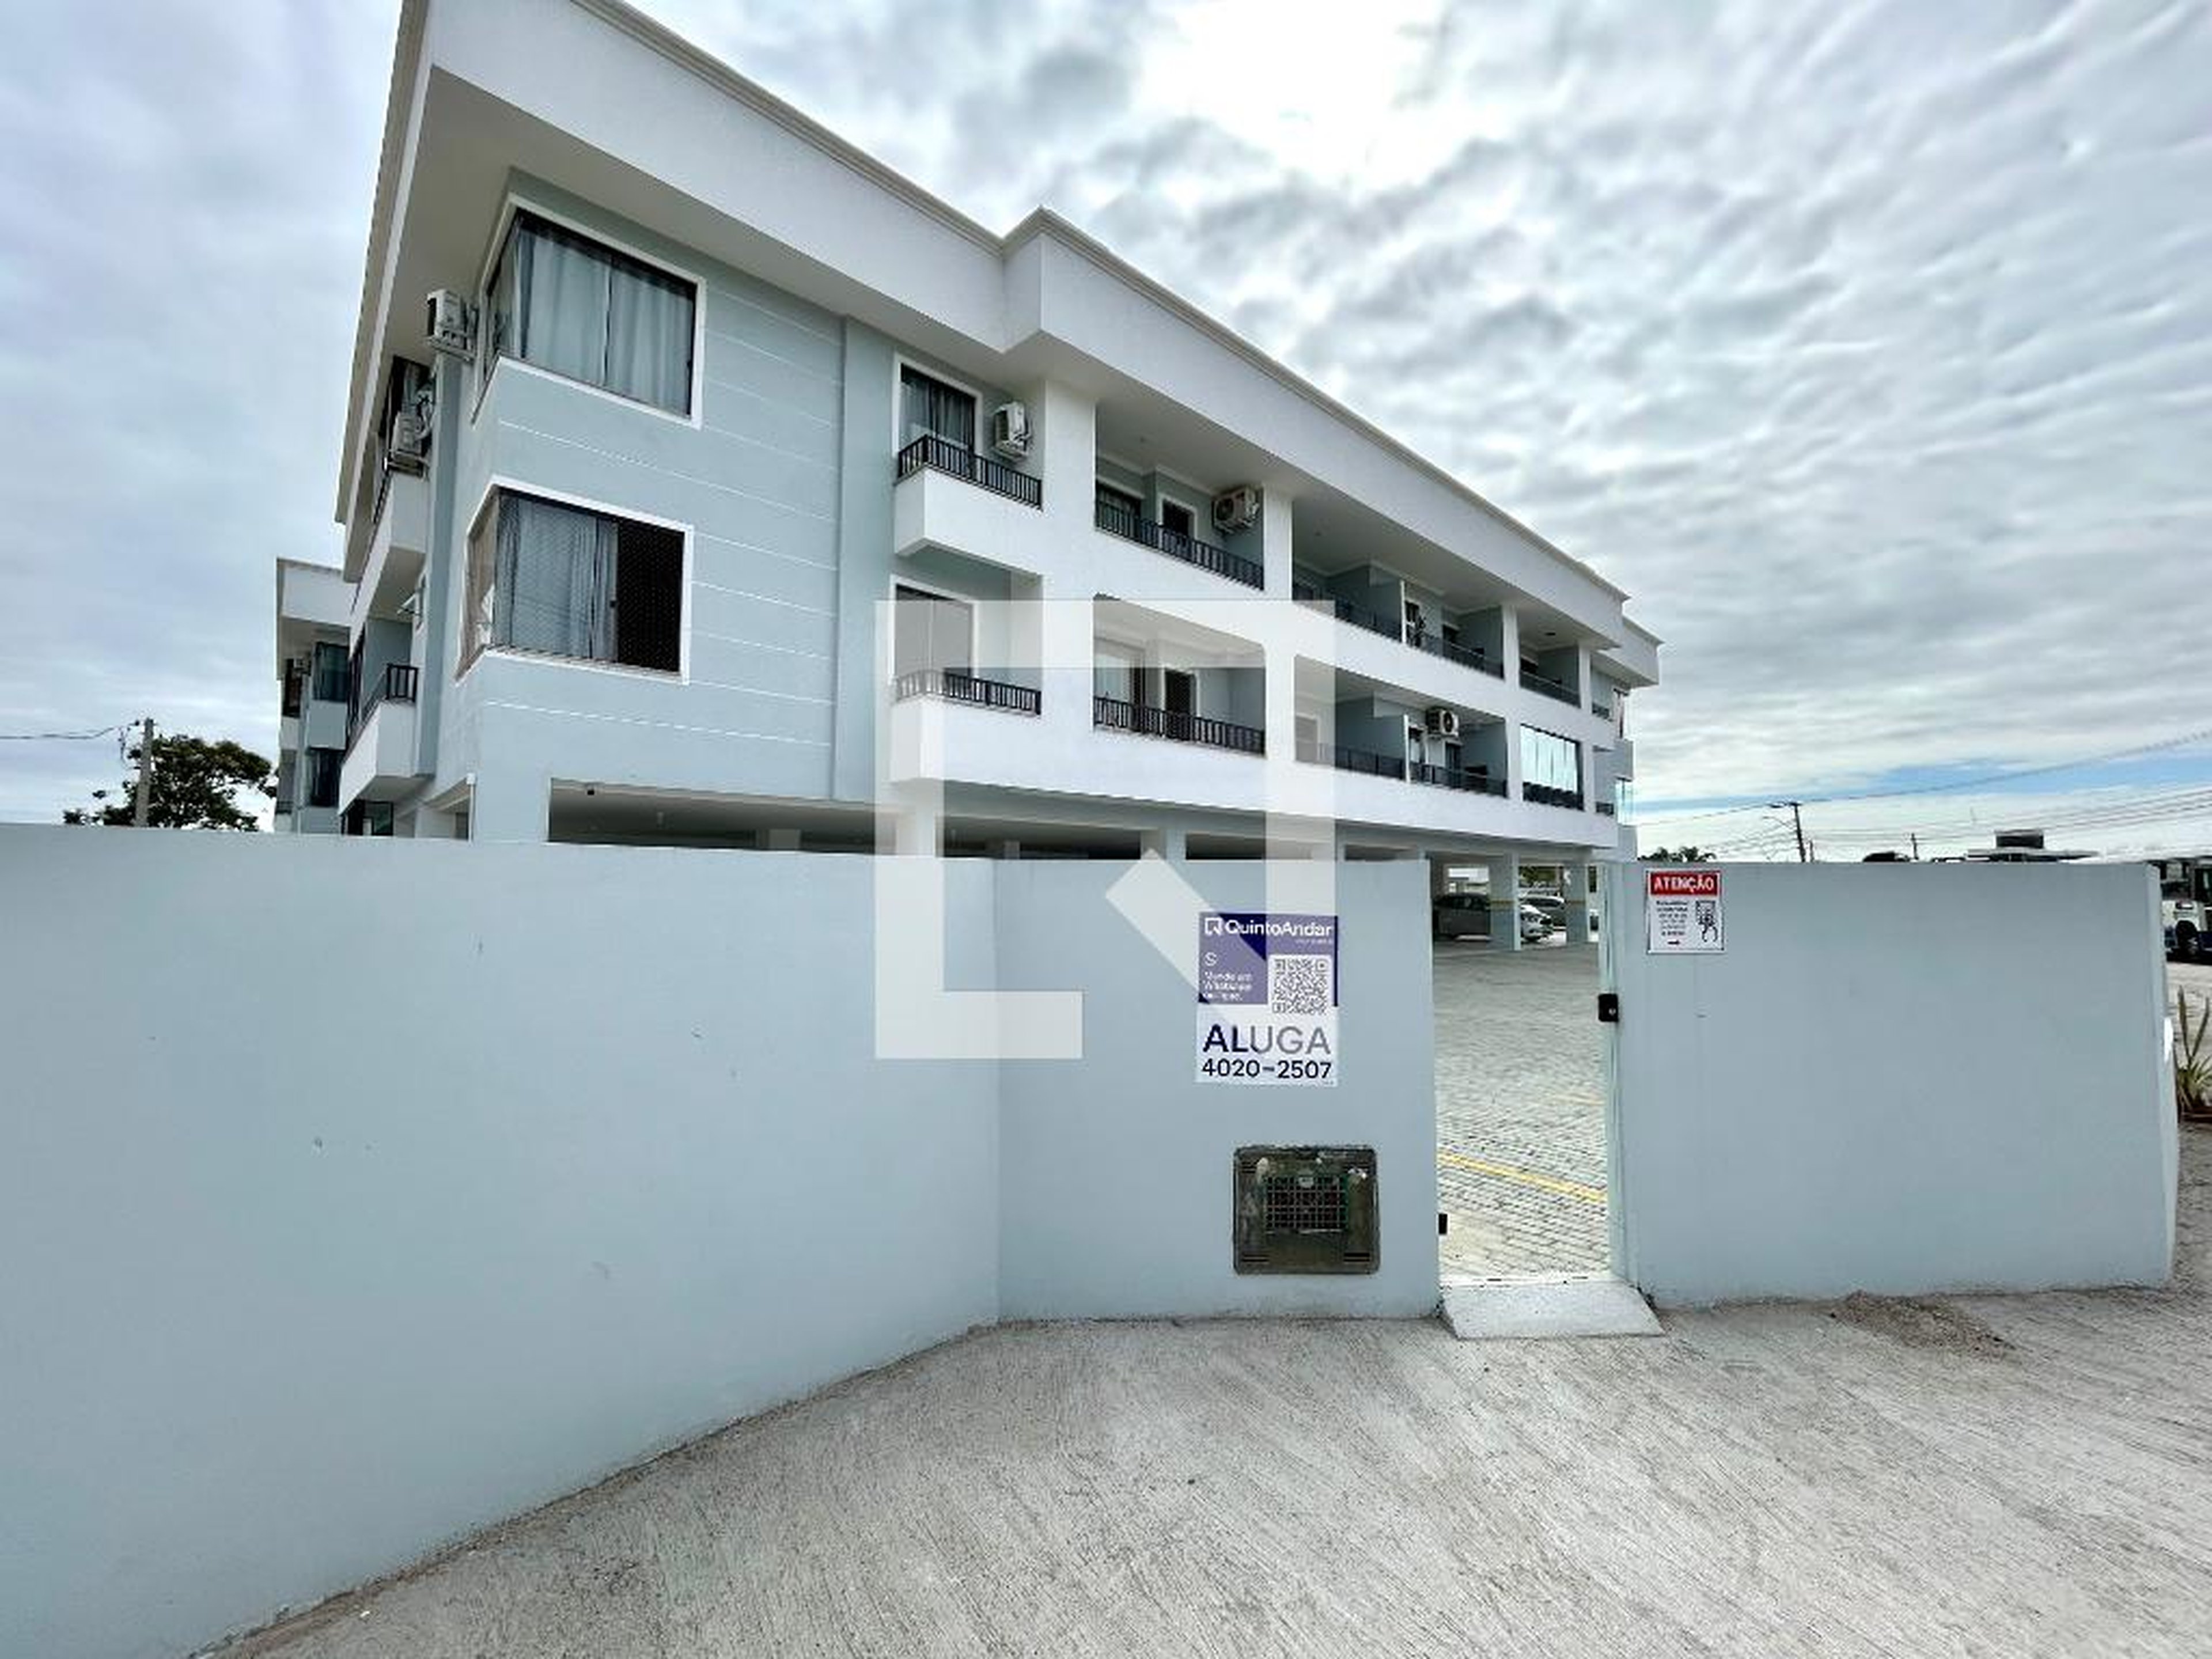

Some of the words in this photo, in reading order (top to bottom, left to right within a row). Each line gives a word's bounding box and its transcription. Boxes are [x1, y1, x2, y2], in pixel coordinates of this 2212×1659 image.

[1654, 875, 1714, 892] ATENÇÃO
[1225, 920, 1331, 936] QuintoAndar
[1203, 1024, 1331, 1054] ALUGA
[1202, 1058, 1331, 1078] 4020-2507
